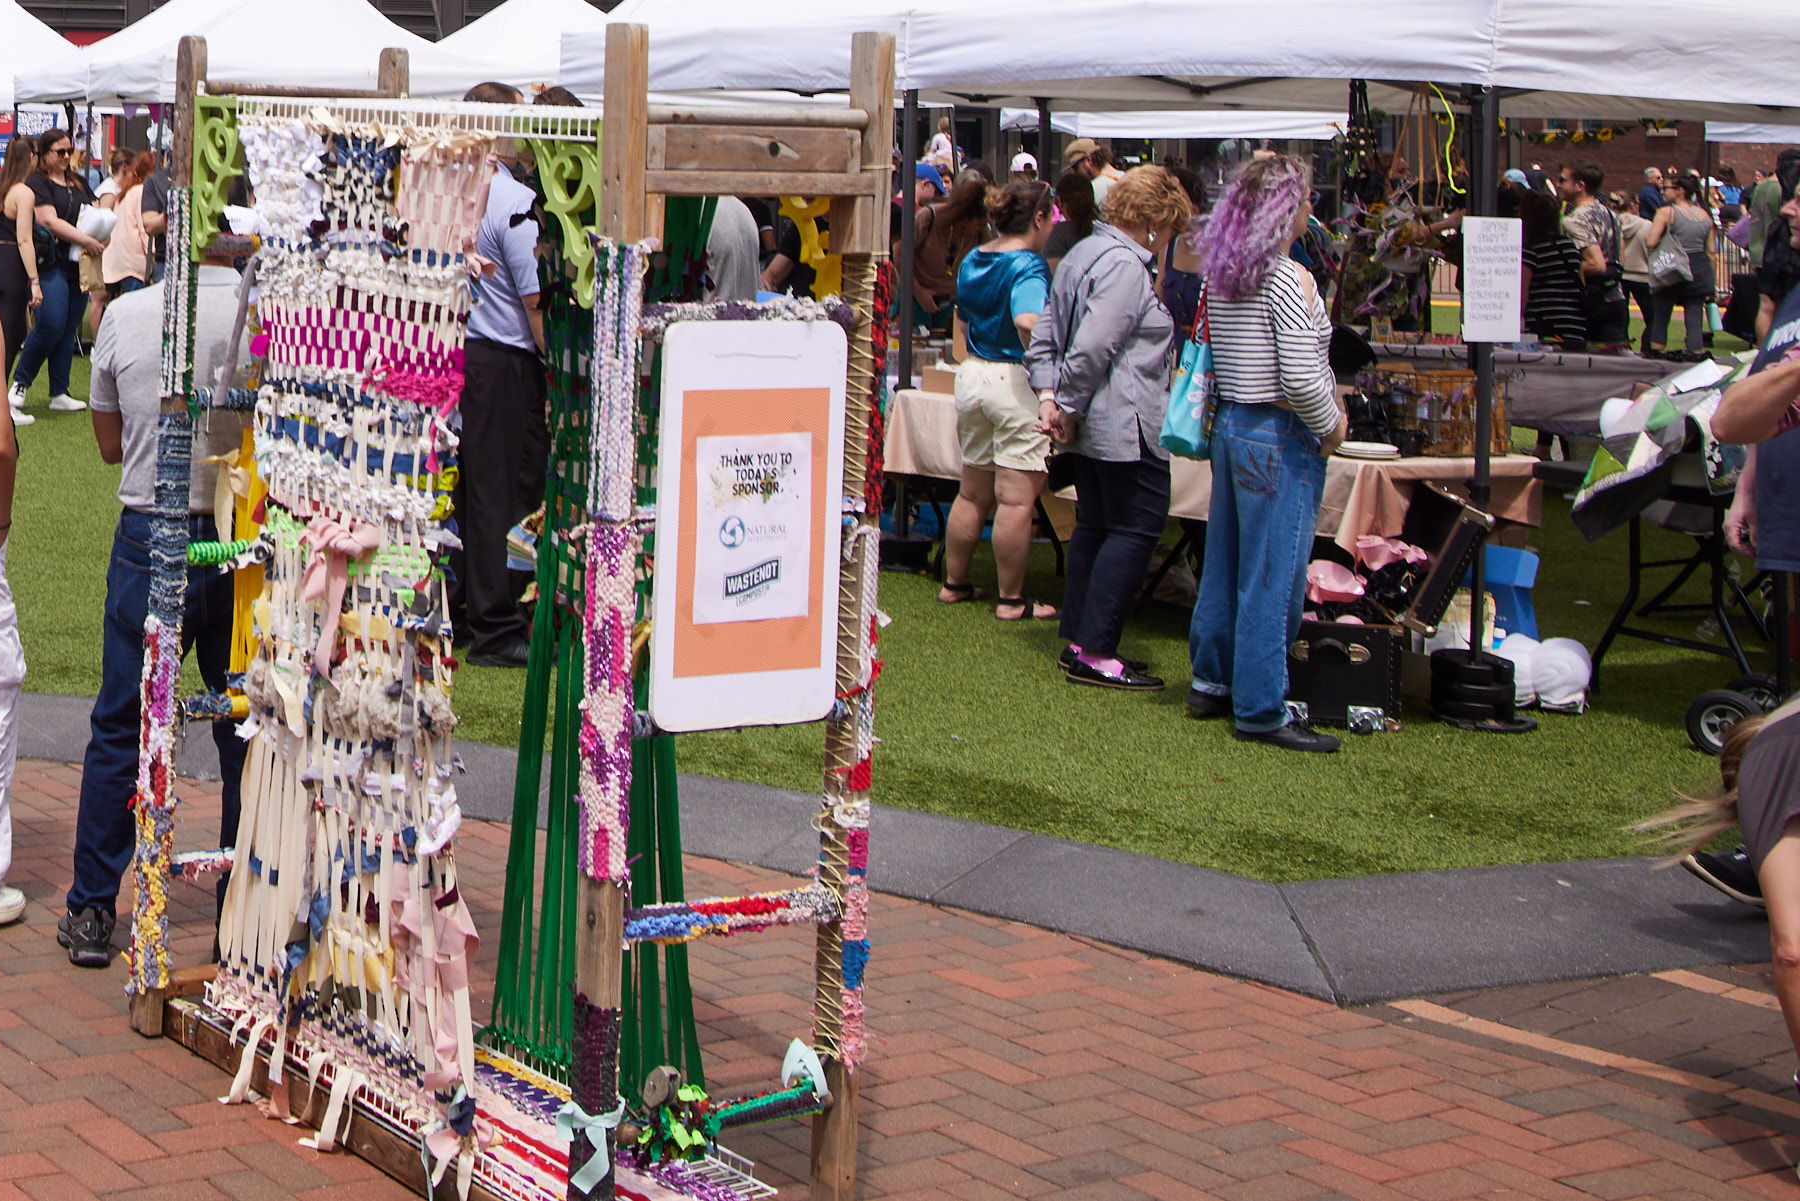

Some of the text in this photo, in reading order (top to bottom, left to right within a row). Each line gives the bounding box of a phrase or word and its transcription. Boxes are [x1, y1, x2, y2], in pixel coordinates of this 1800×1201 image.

[721, 452, 792, 468] THANK YOU TO
[736, 467, 777, 482] TODAY'S
[746, 524, 788, 536] NATURAL
[726, 561, 779, 594] WASTENOT
[738, 586, 767, 605] COMPOST
